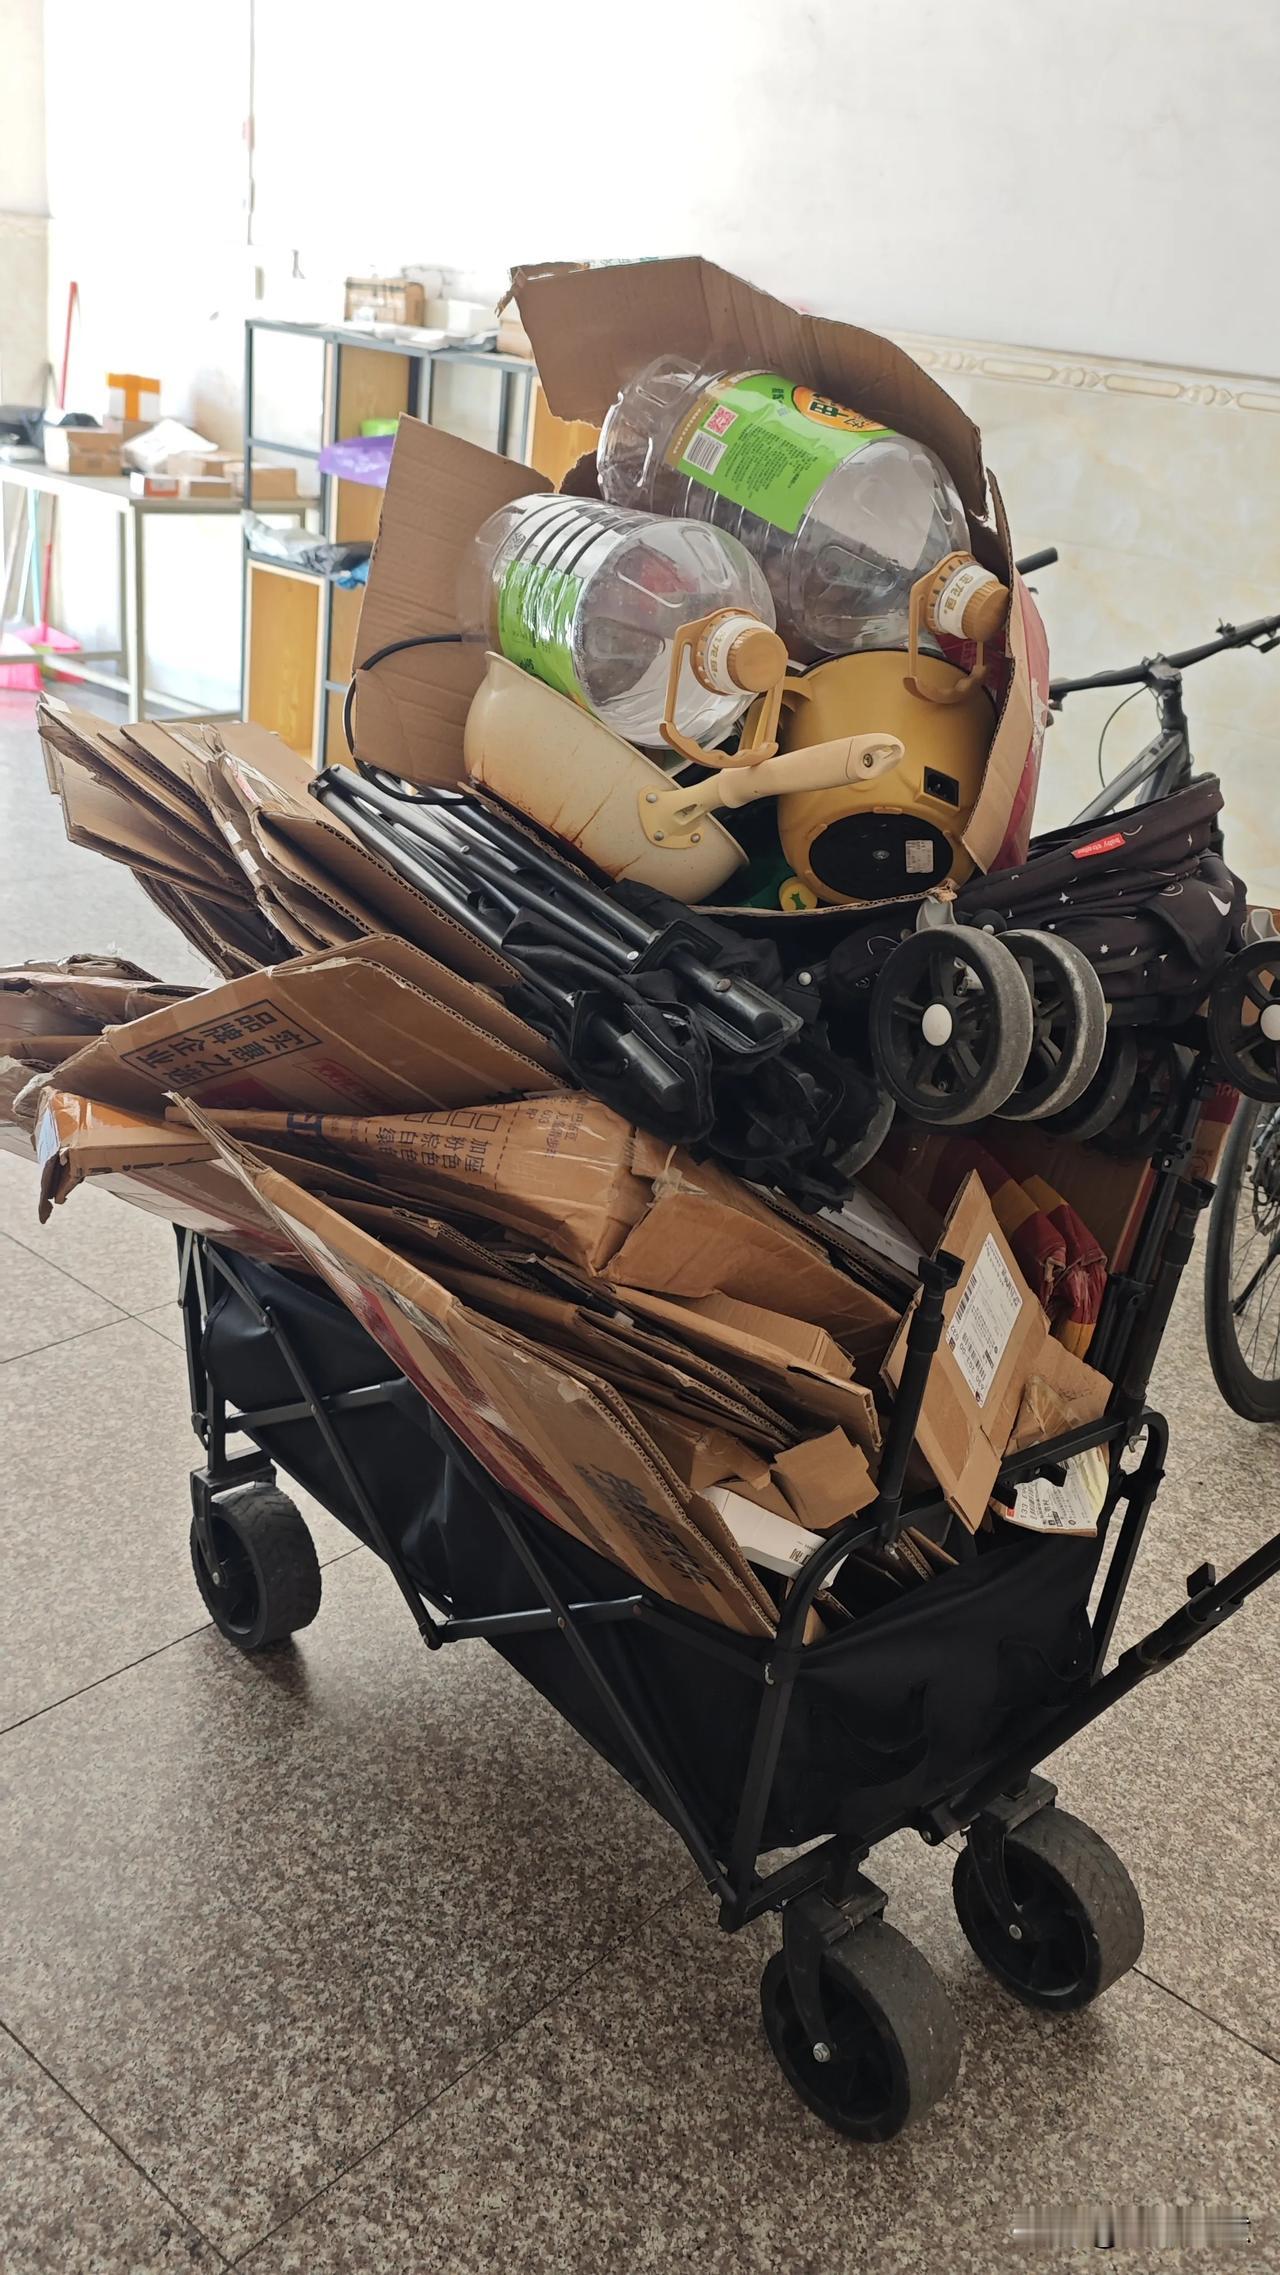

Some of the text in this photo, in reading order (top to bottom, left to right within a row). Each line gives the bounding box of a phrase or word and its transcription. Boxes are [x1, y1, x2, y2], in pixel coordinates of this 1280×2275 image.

[136, 1011, 278, 1069] 品牌企业
[163, 1029, 305, 1084] 实惠之选
[400, 1131, 419, 1161] 白色
[421, 1132, 443, 1166] 棕色
[443, 1135, 468, 1169] 粉色
[465, 1137, 492, 1174] 加座
